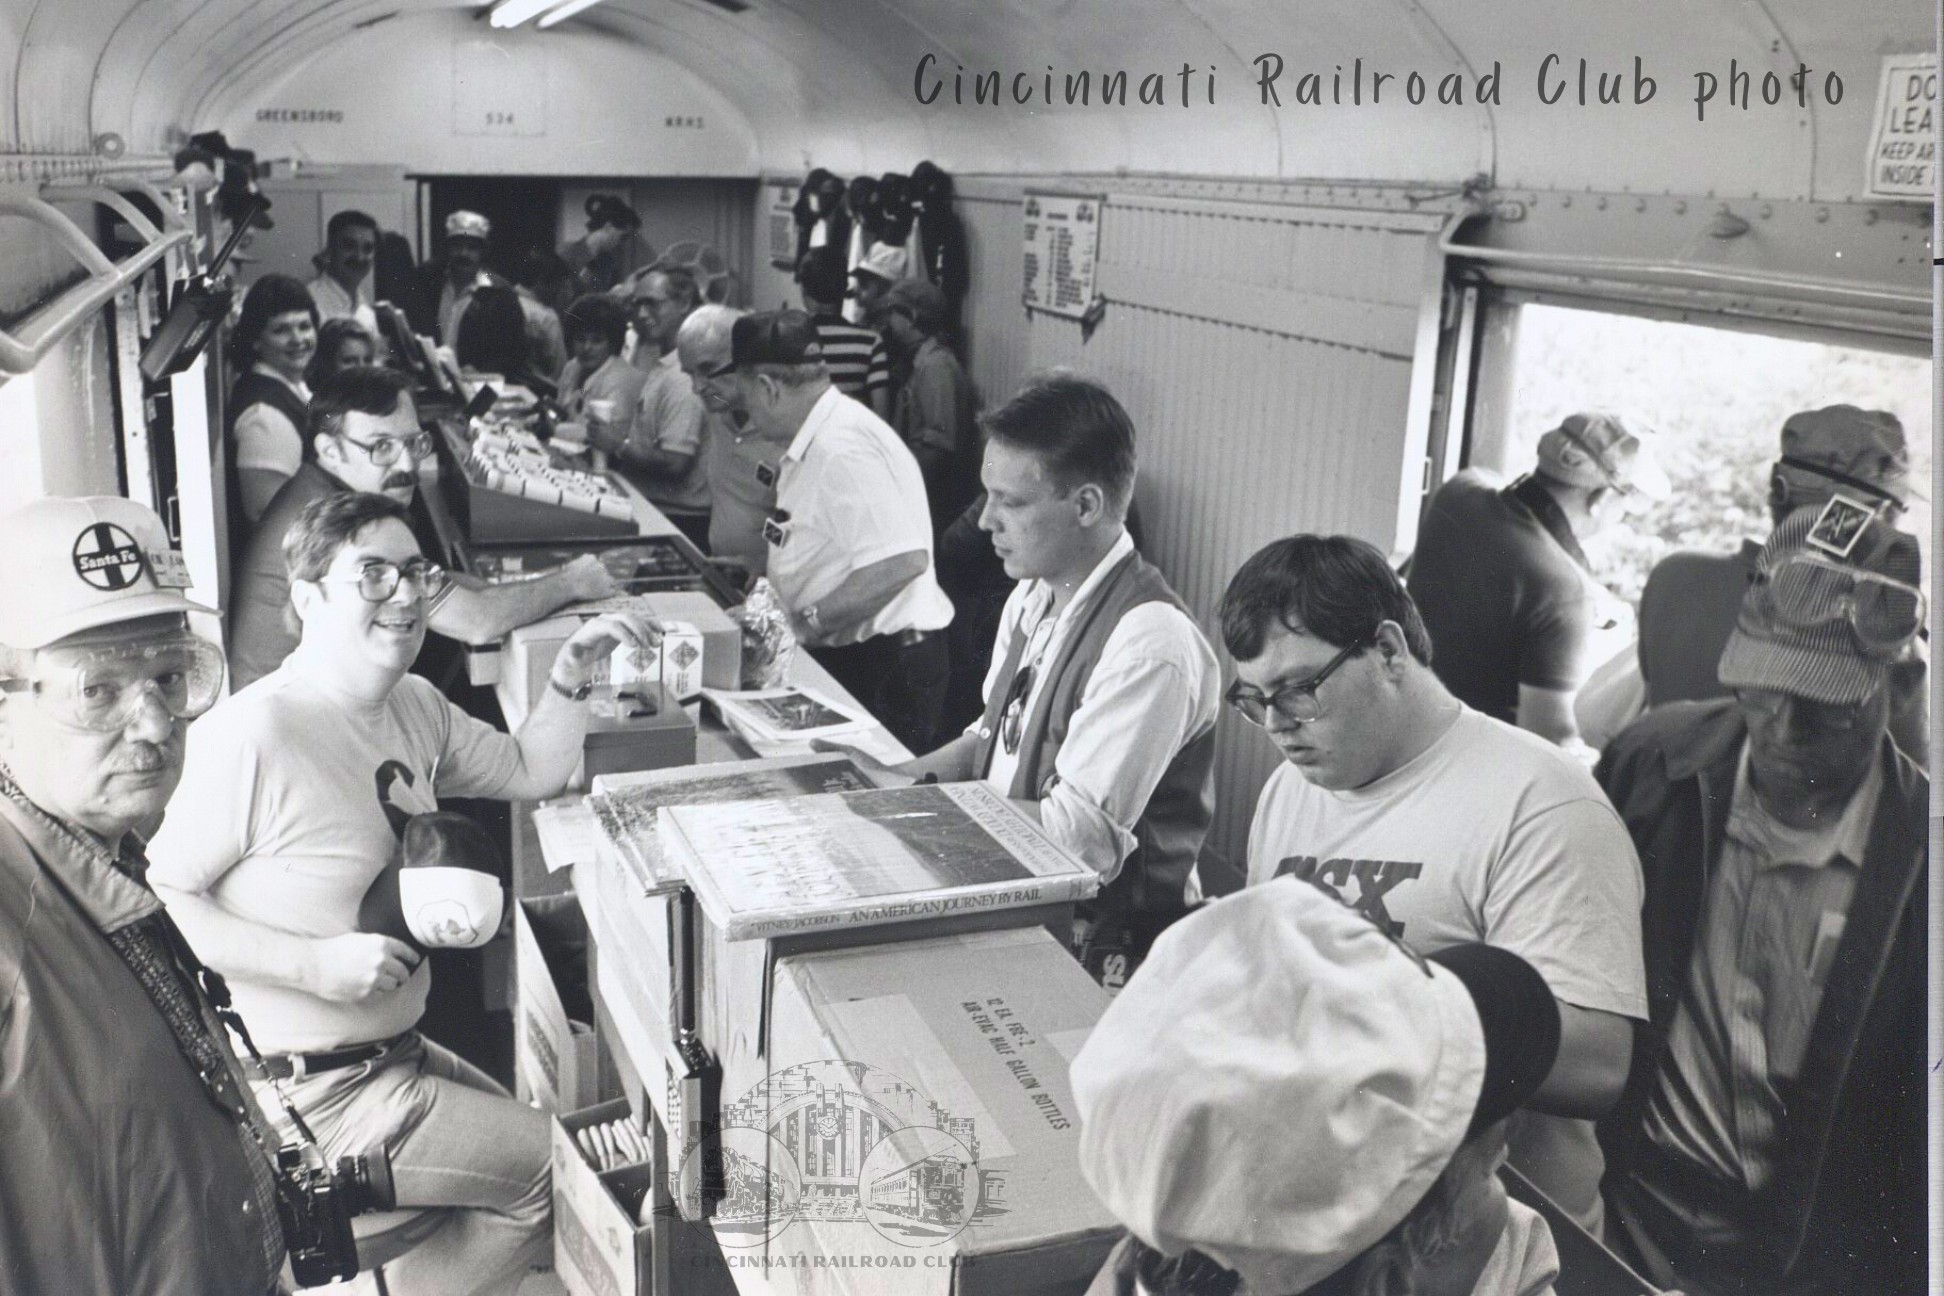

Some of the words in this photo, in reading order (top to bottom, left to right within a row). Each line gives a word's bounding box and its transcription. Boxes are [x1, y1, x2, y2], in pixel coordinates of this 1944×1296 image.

[1880, 142, 1916, 160] KEEP
[1880, 165, 1927, 185] INSIDE
[79, 554, 120, 571] Santa
[119, 549, 137, 562] Fe
[849, 910, 870, 923] AN
[870, 901, 940, 920] AMERICAN
[938, 894, 998, 915] JOURNEY
[995, 893, 1013, 905] BY
[1014, 889, 1042, 902] RAIL
[988, 1037, 1016, 1055] HALF
[1005, 1060, 1041, 1089] GALLON
[1031, 1093, 1071, 1130] BOTTLES
